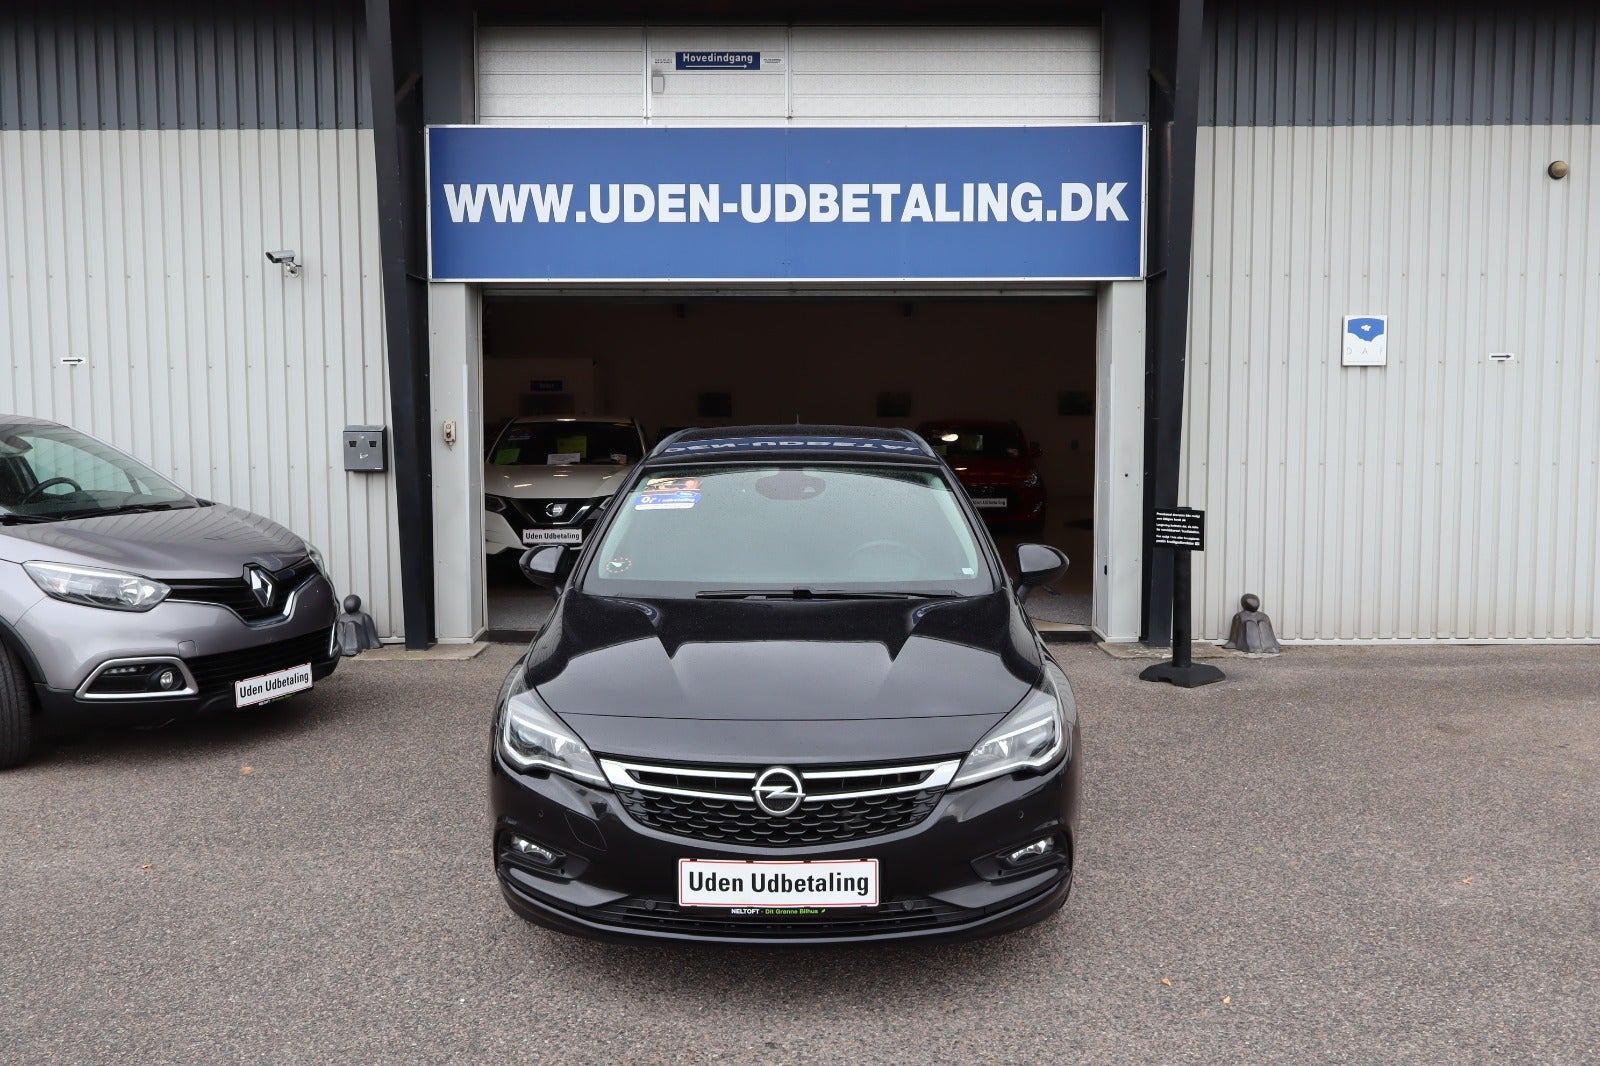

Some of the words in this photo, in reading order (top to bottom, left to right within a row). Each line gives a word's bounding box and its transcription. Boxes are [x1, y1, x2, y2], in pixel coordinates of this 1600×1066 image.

[682, 53, 753, 64] Hovedindgang
[443, 182, 1129, 223] WWW.UDEN-UDBETALING.DK
[525, 532, 543, 540] Uden
[544, 531, 580, 541] Udbetaling
[239, 685, 263, 698] Uden
[265, 672, 309, 692] Udbetaling
[689, 871, 744, 892] Uden
[751, 871, 869, 896] Udbetaling
